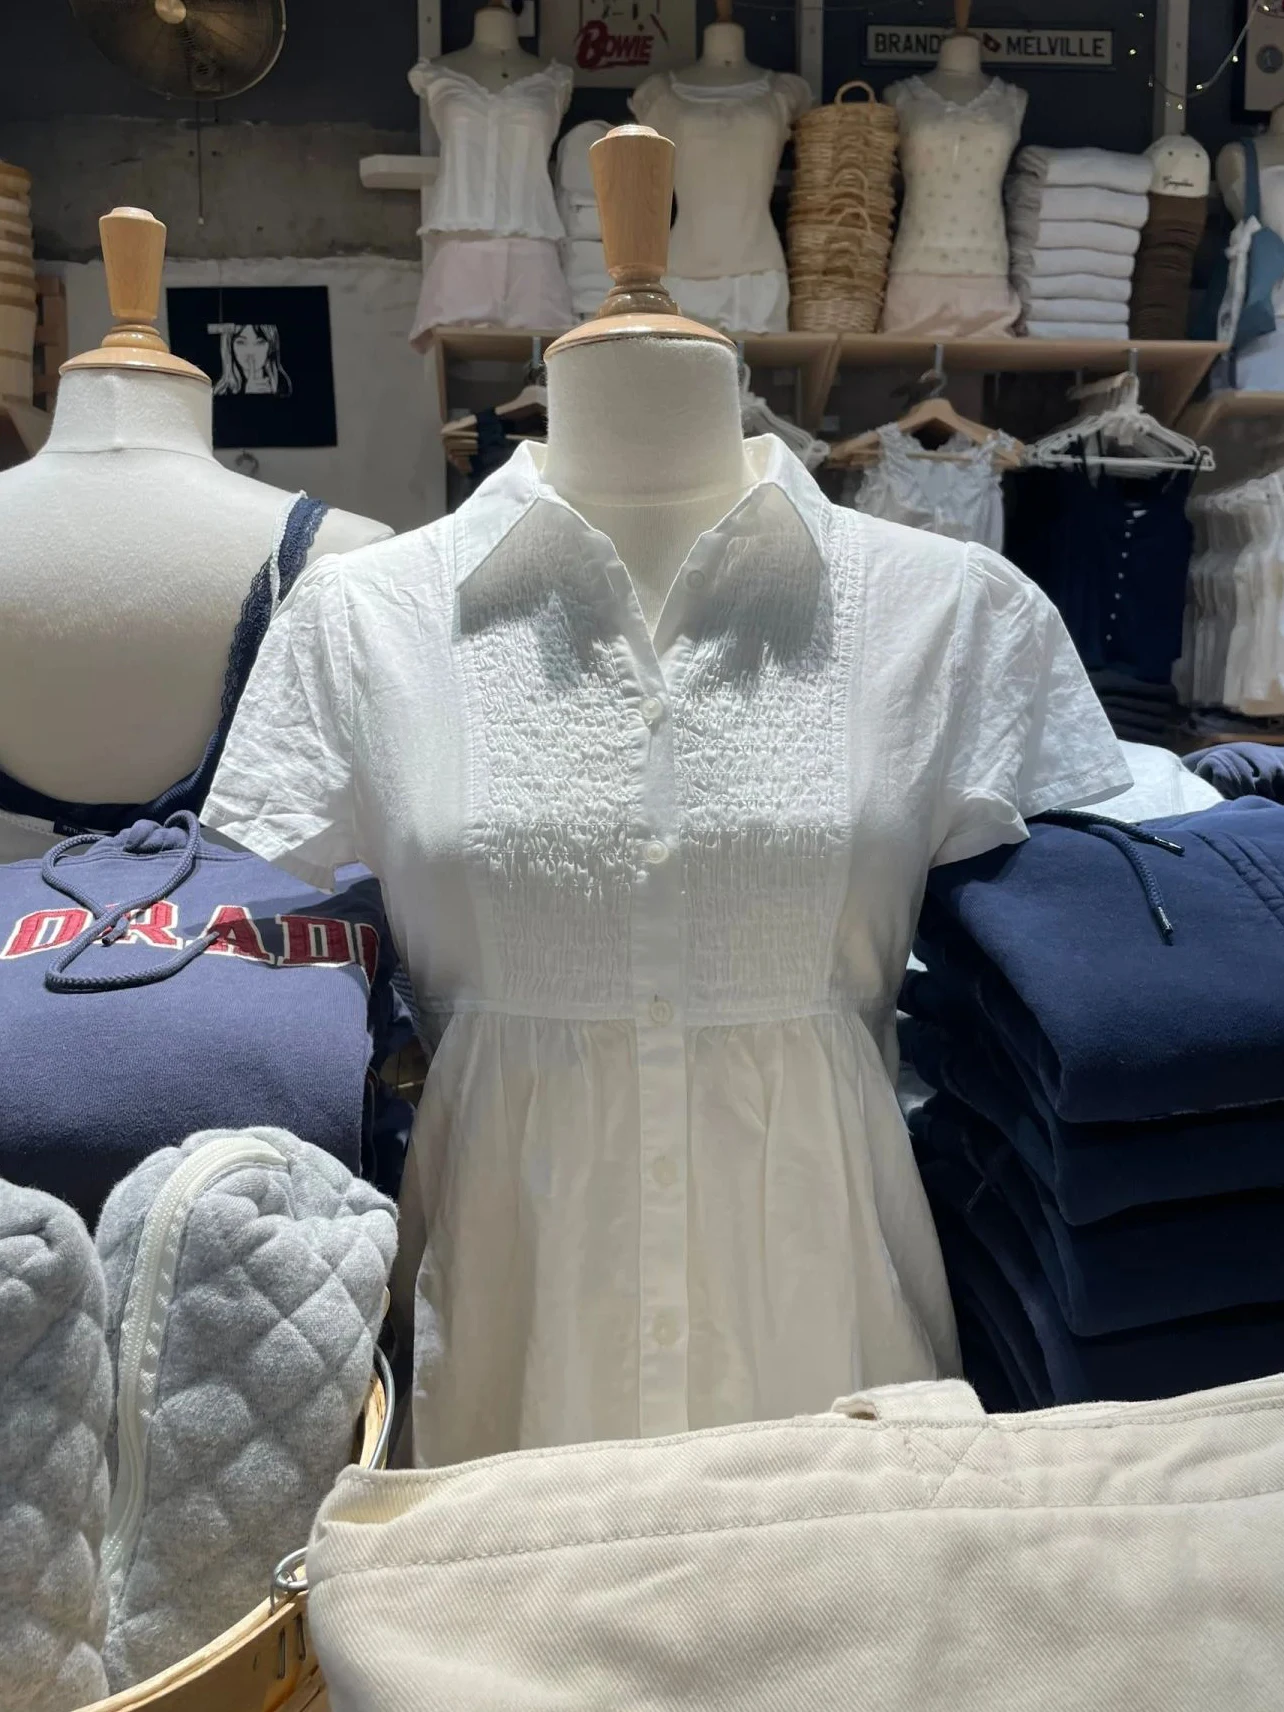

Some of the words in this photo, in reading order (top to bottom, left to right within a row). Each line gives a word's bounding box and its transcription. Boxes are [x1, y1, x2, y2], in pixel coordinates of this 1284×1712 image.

[577, 20, 654, 68] BOWIE
[874, 32, 946, 54] BRAND
[1006, 35, 1105, 58] MELVILLE
